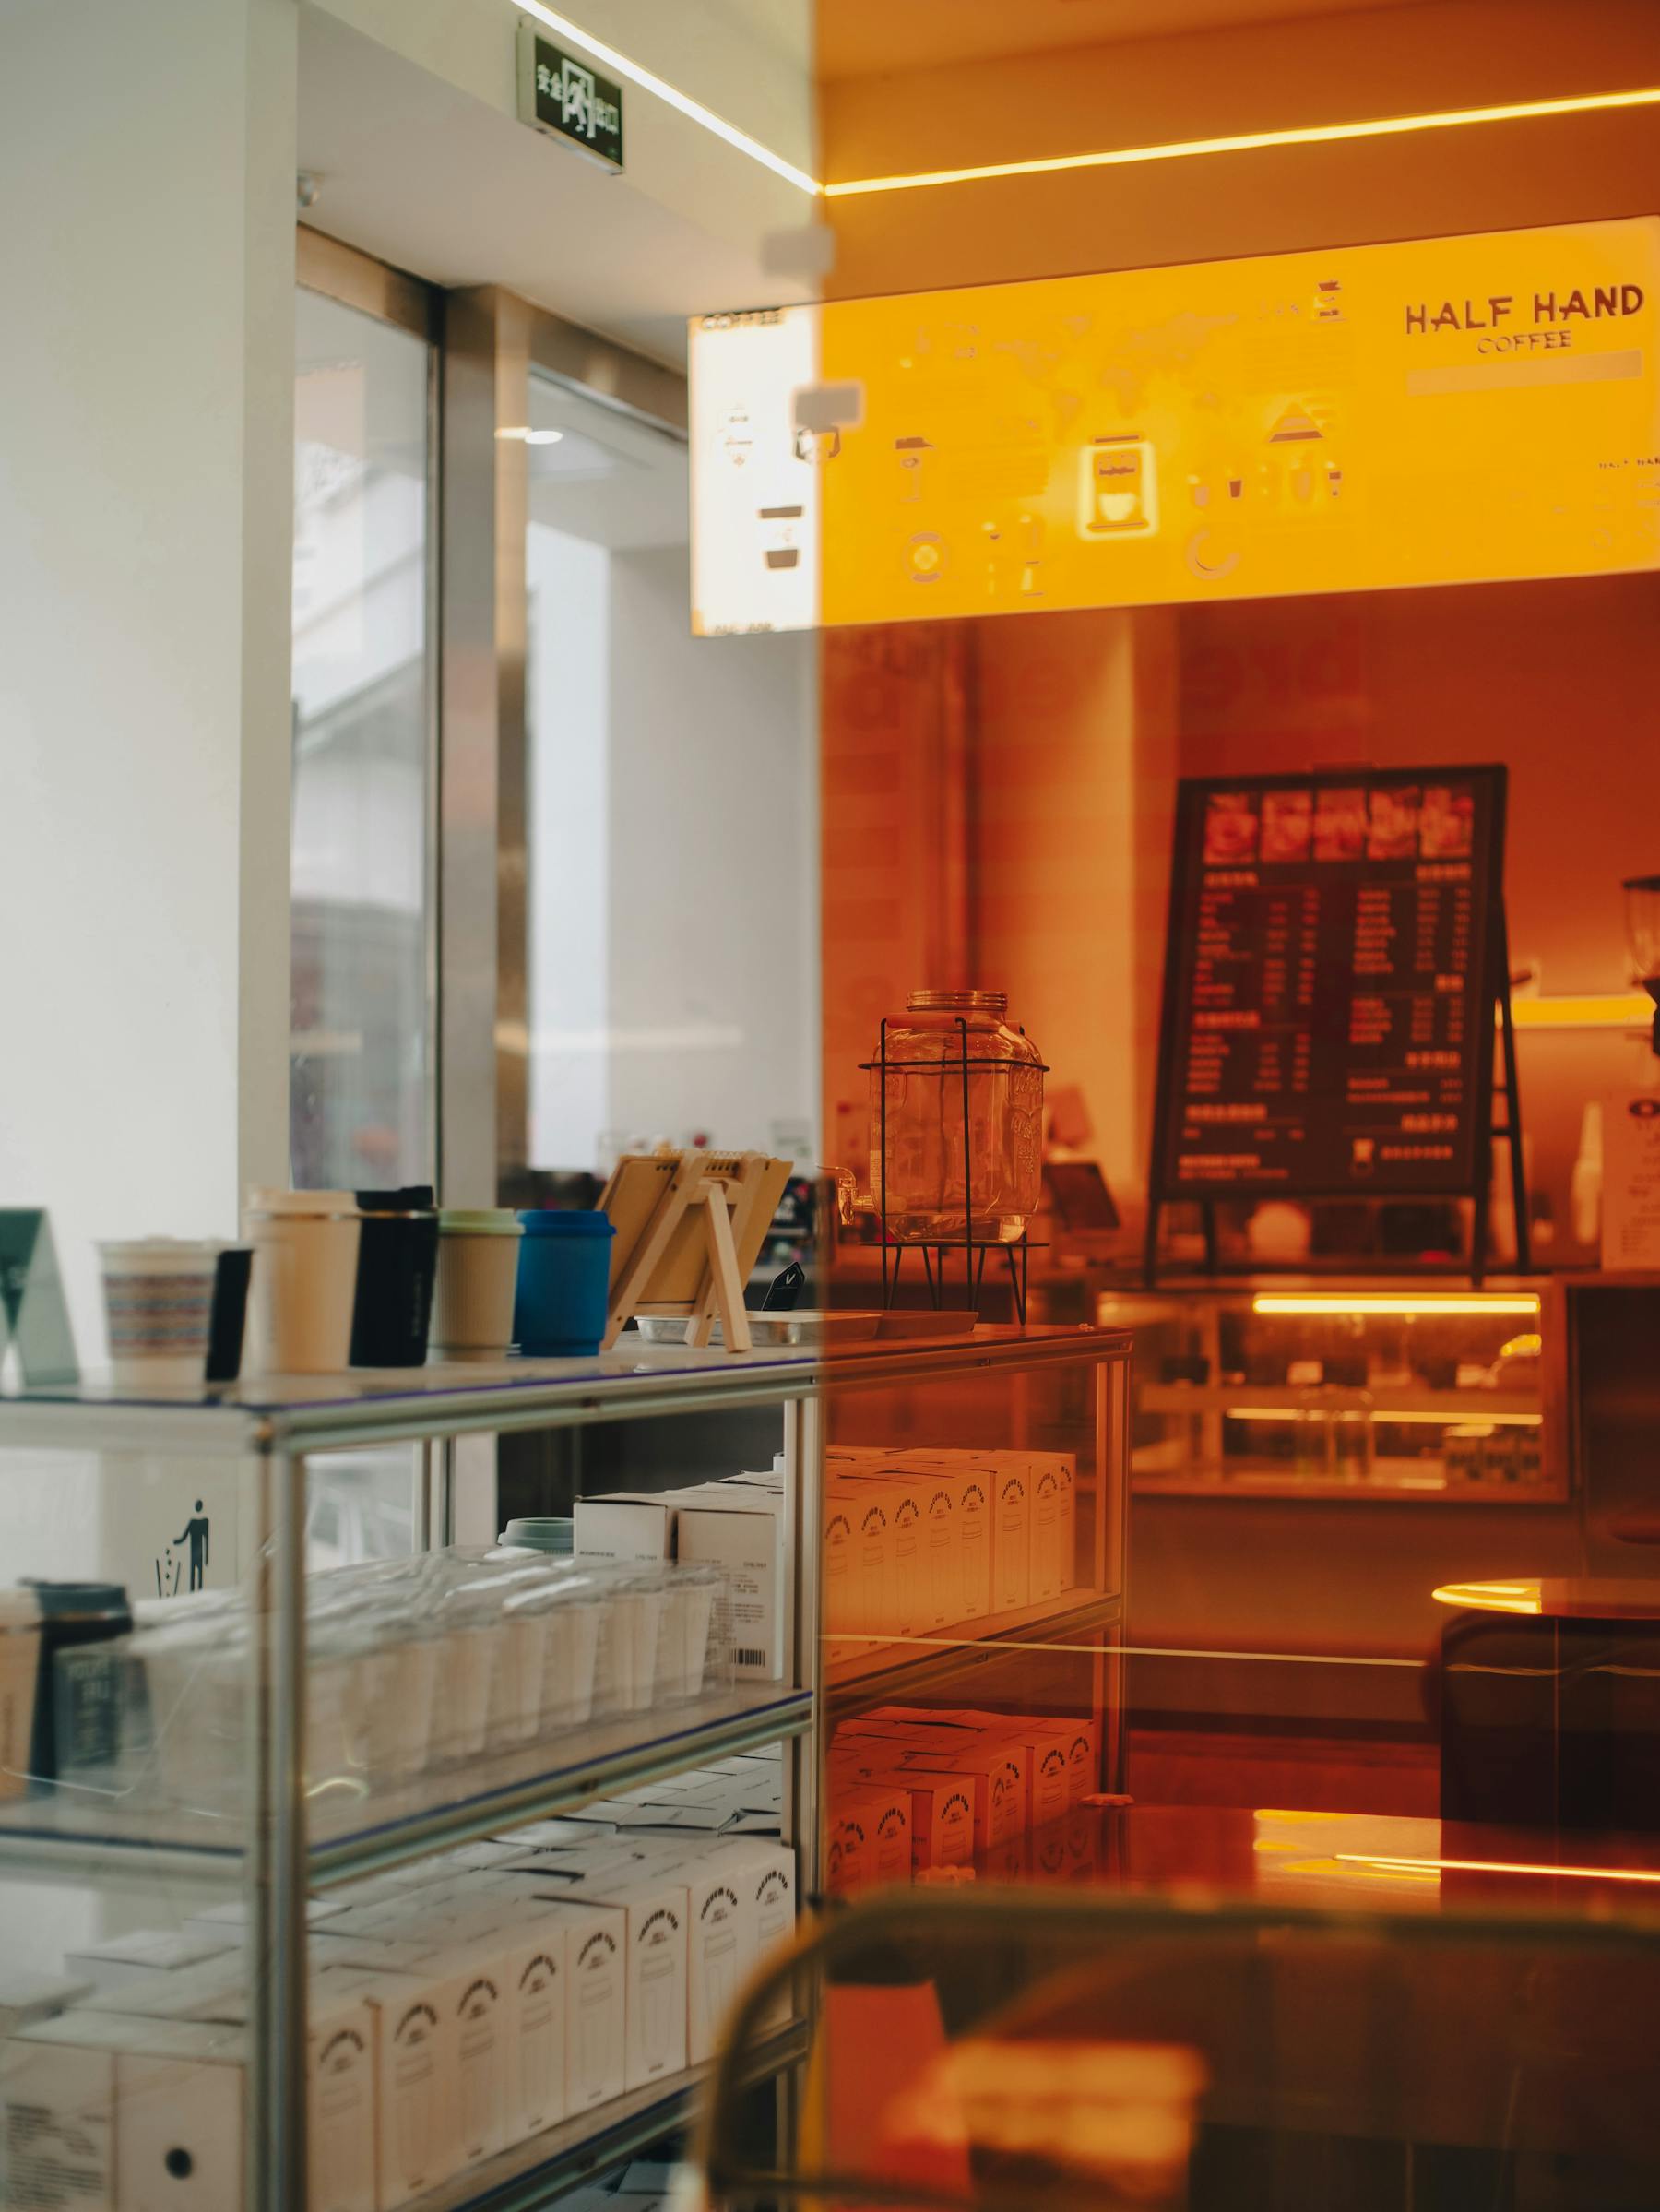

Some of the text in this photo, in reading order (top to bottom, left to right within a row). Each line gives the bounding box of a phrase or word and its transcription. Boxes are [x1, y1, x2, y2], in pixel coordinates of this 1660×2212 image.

[1406, 284, 1644, 335] HALF HAND
[1476, 330, 1572, 354] COFFEE
